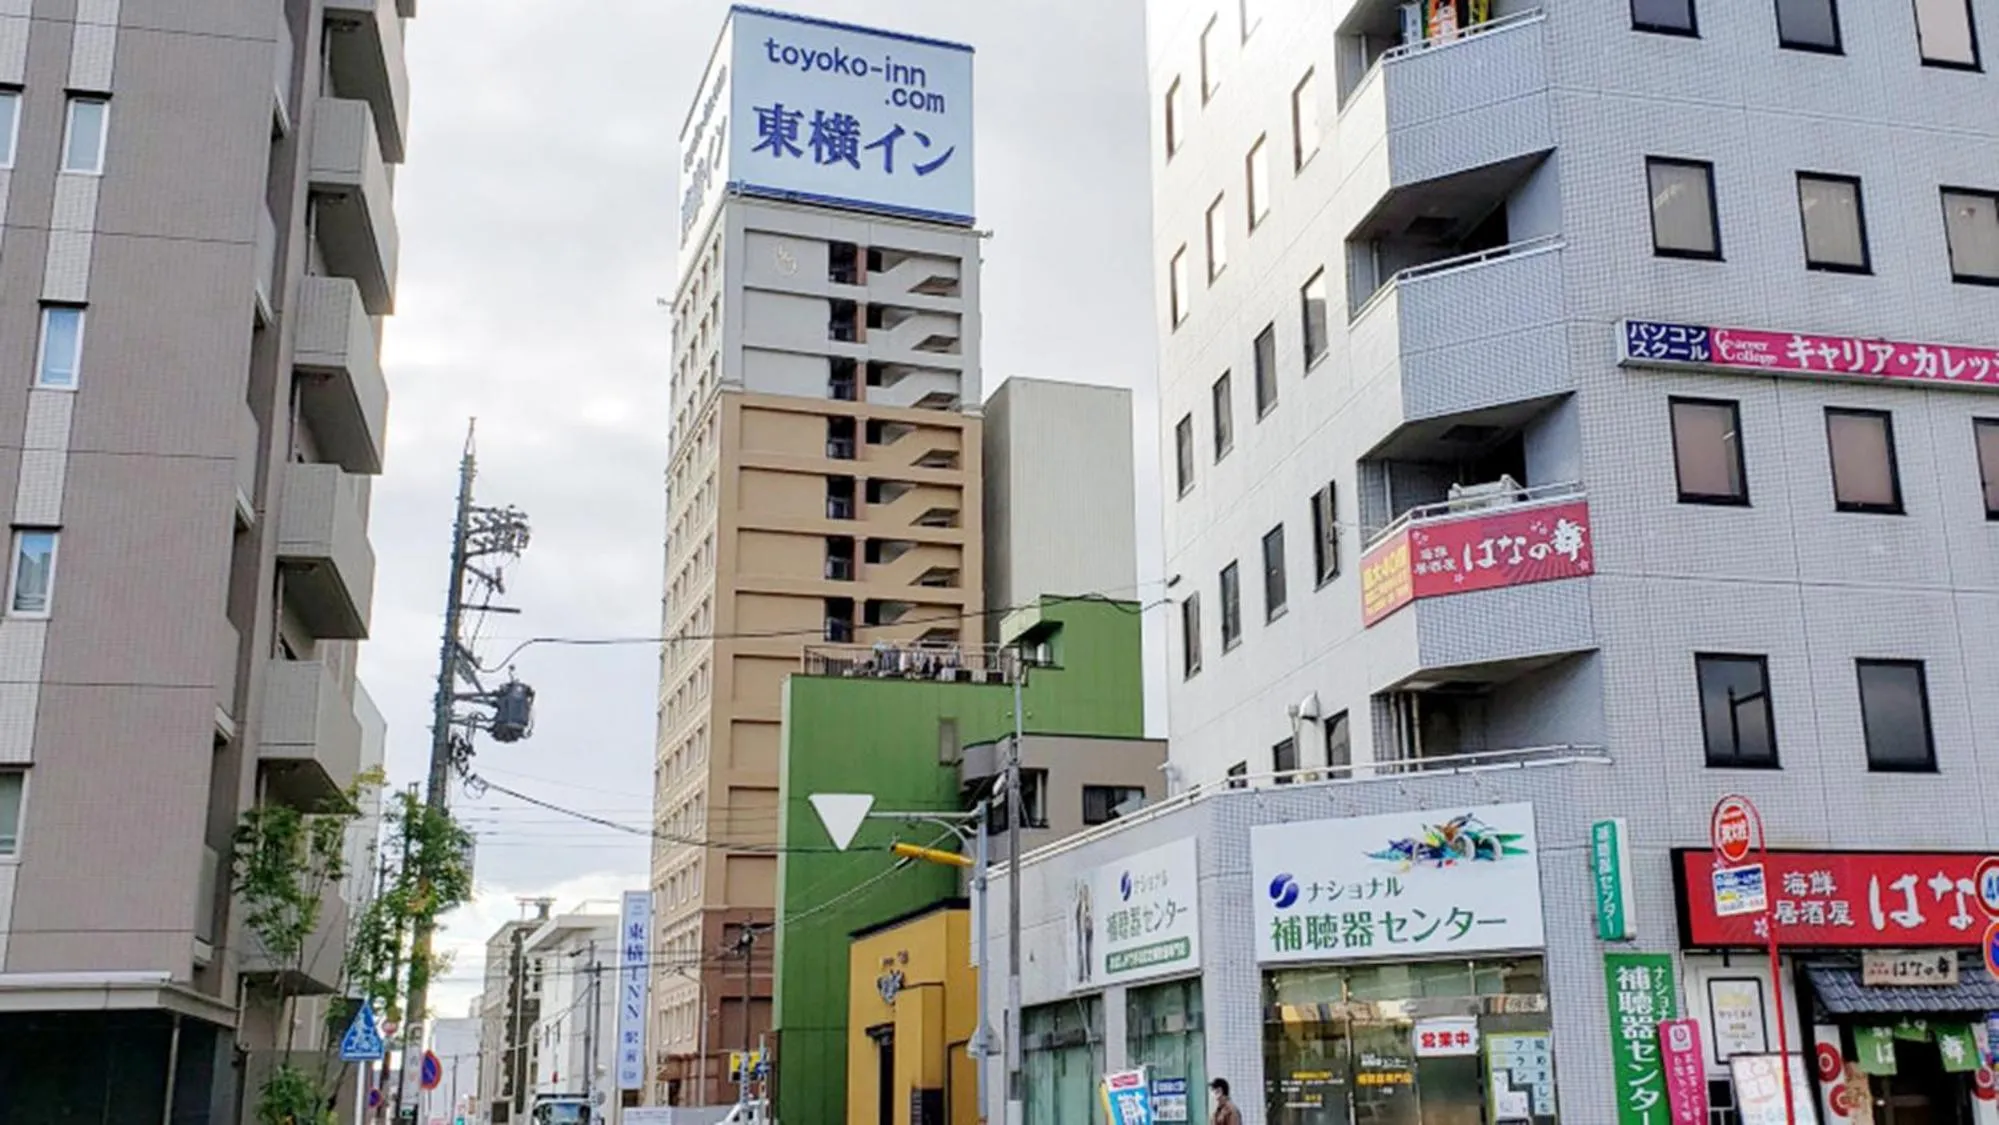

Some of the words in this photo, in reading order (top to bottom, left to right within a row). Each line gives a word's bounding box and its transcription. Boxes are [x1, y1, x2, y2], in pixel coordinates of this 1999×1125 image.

[765, 37, 926, 88] toyoko-inn
[885, 87, 945, 114] .com
[751, 102, 956, 177] 東横イン
[1628, 322, 1706, 344] パソコン
[1631, 340, 1709, 361] スクール
[1306, 876, 1405, 902] ナショナル
[1783, 871, 1837, 897] 海鮮
[1774, 900, 1855, 927] 居酒屋
[1270, 905, 1507, 952] 補聴器センター
[1421, 1030, 1471, 1049] 営業中
